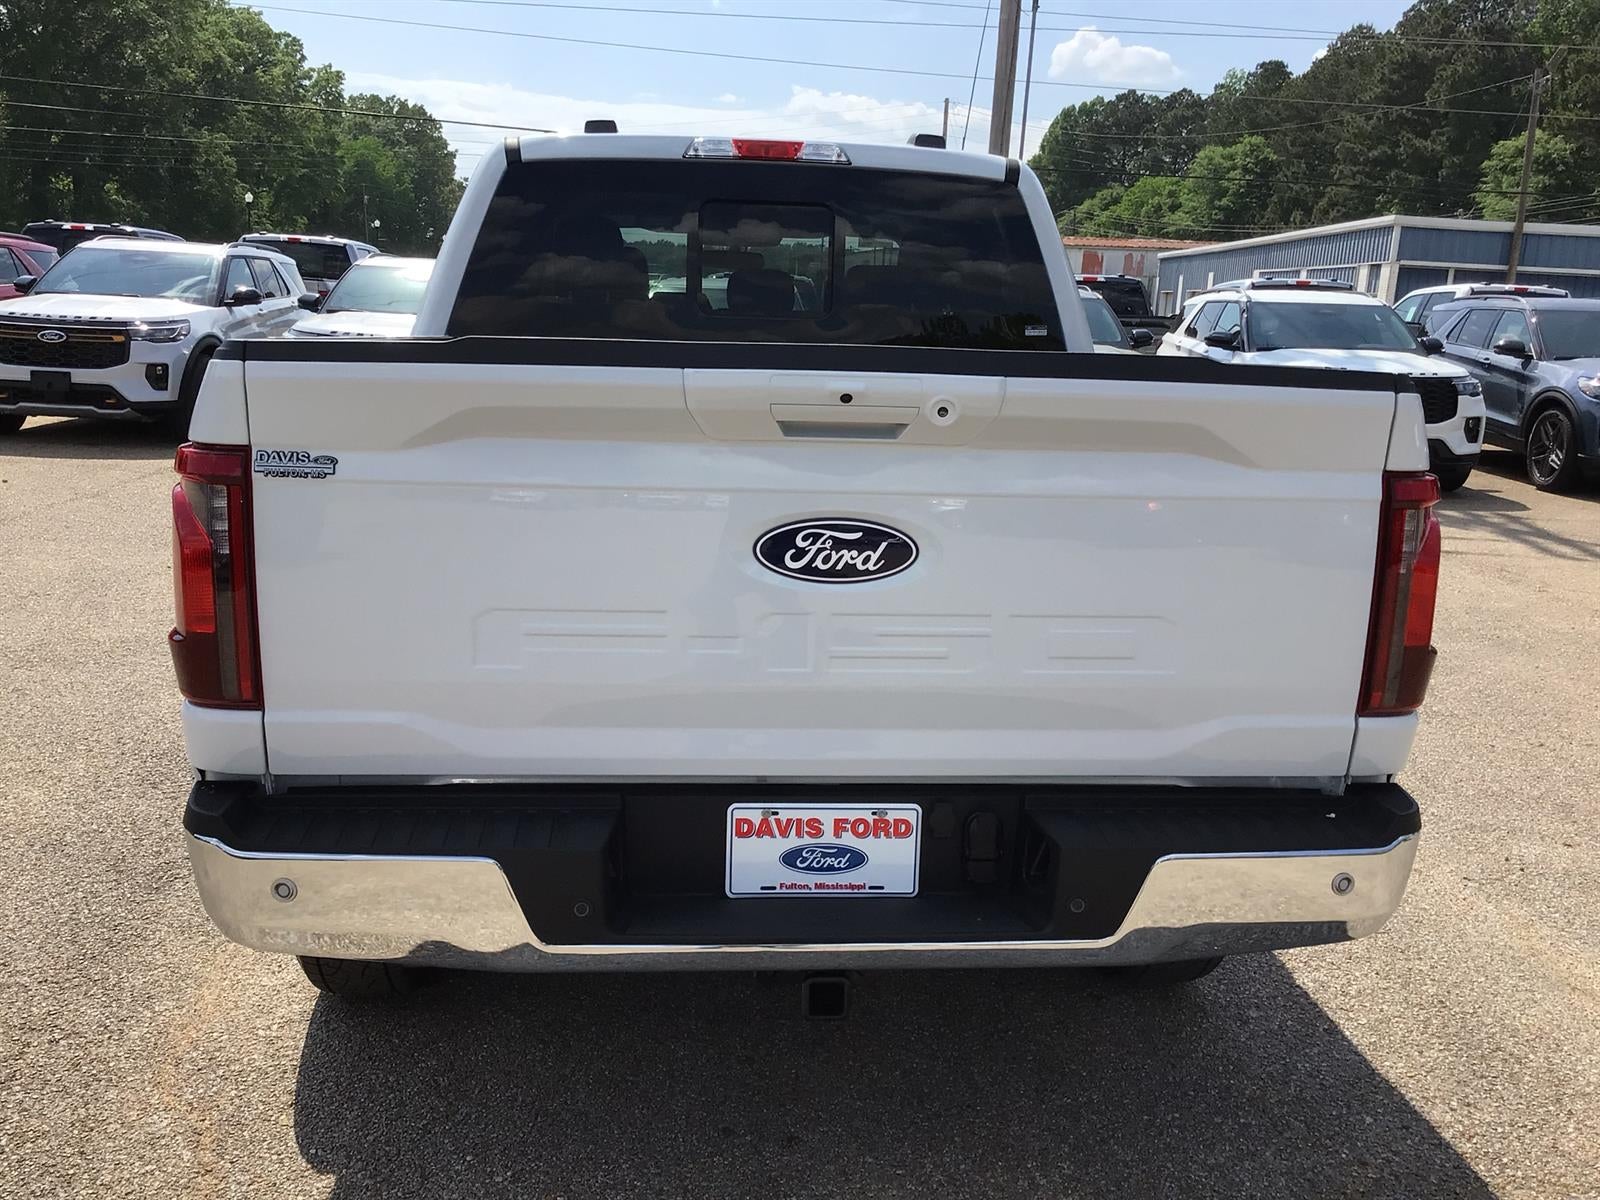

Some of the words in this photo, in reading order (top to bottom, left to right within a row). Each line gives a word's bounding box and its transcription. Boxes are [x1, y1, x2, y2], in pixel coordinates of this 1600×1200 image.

[256, 450, 310, 465] DAVIS
[311, 469, 326, 479] MS
[784, 528, 888, 571] Ford
[735, 817, 825, 839] DAVIS
[832, 818, 914, 840] FORD
[796, 847, 851, 868] Ford
[779, 882, 812, 891] Fulton,
[814, 882, 866, 891] Mississippi
